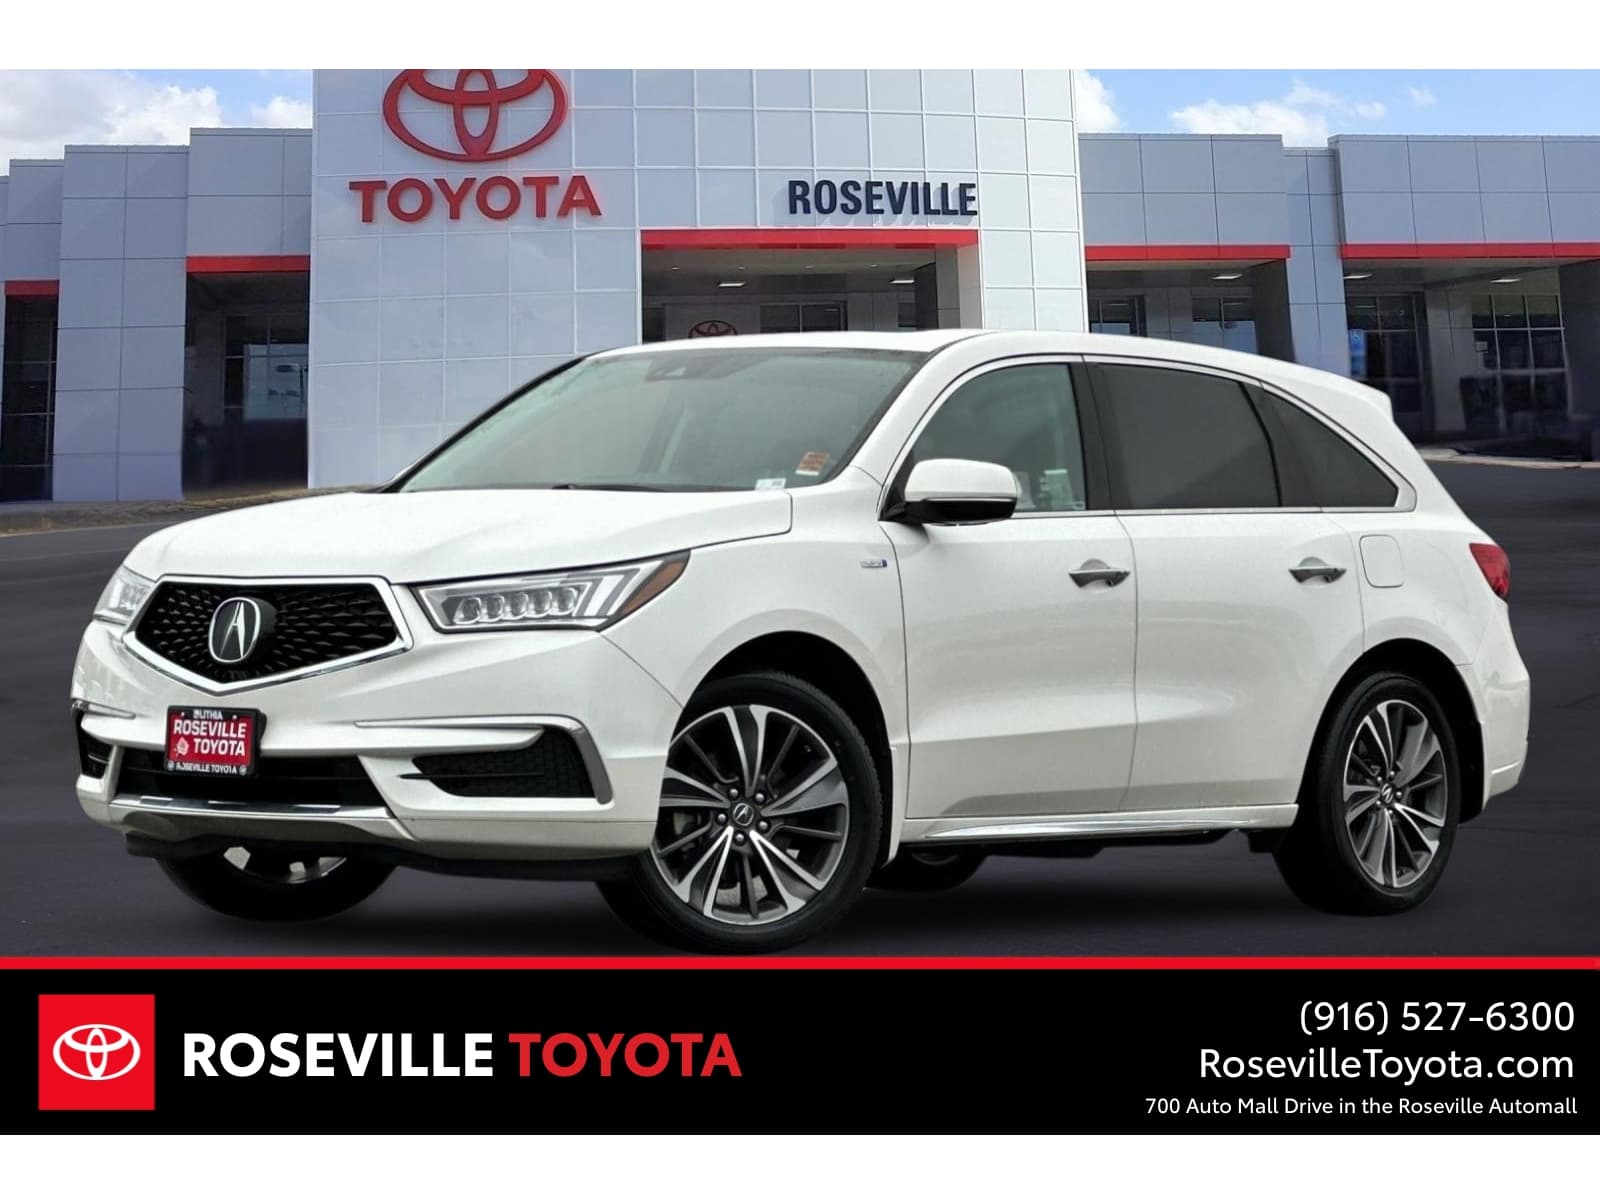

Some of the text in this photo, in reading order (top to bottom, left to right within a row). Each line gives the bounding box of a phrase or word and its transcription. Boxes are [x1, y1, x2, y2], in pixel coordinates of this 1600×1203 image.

[349, 175, 602, 223] TOYOTA
[788, 179, 978, 217] ROSEVILLE
[173, 719, 247, 739] ROSEVILLE
[193, 738, 246, 757] TOYOTA
